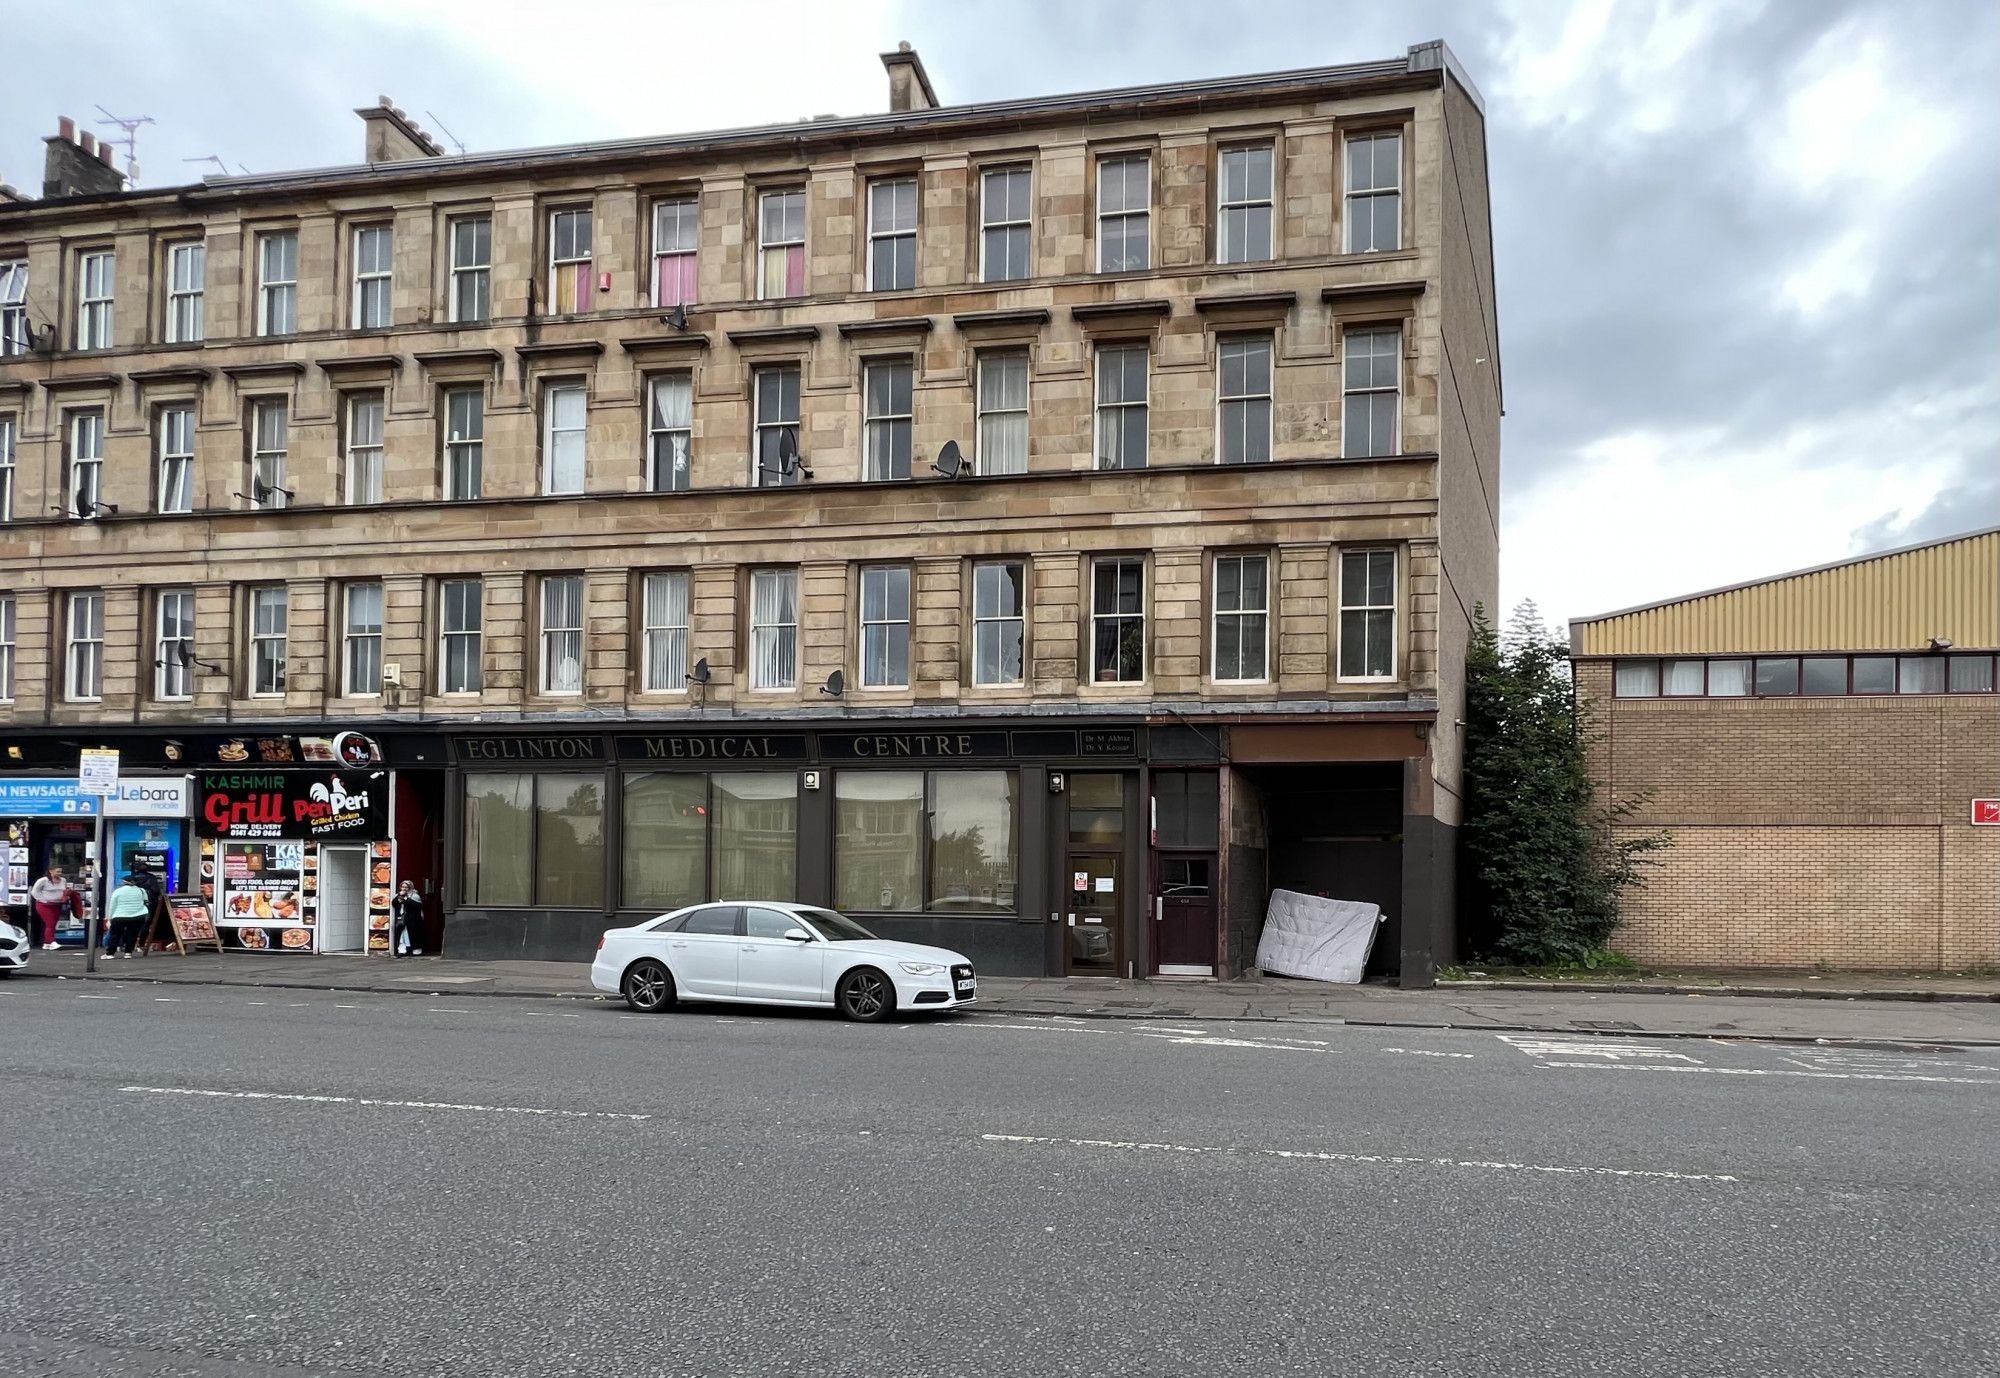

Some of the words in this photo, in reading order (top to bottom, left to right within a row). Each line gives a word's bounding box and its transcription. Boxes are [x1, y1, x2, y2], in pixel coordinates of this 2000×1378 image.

[466, 738, 594, 759] EGLINTON
[644, 737, 778, 758] MEDICAL
[853, 735, 973, 756] CENTRE
[205, 775, 285, 789] KASHMIR
[121, 786, 179, 801] Lebara
[204, 793, 286, 832] Grill
[293, 799, 331, 822] Peri
[329, 790, 369, 815] Peri
[310, 815, 332, 826] Grilled
[333, 812, 360, 822] Chicken
[311, 822, 335, 835] FAST
[338, 817, 365, 829] FOOD
[230, 829, 247, 837] 0141
[247, 829, 261, 837] 429
